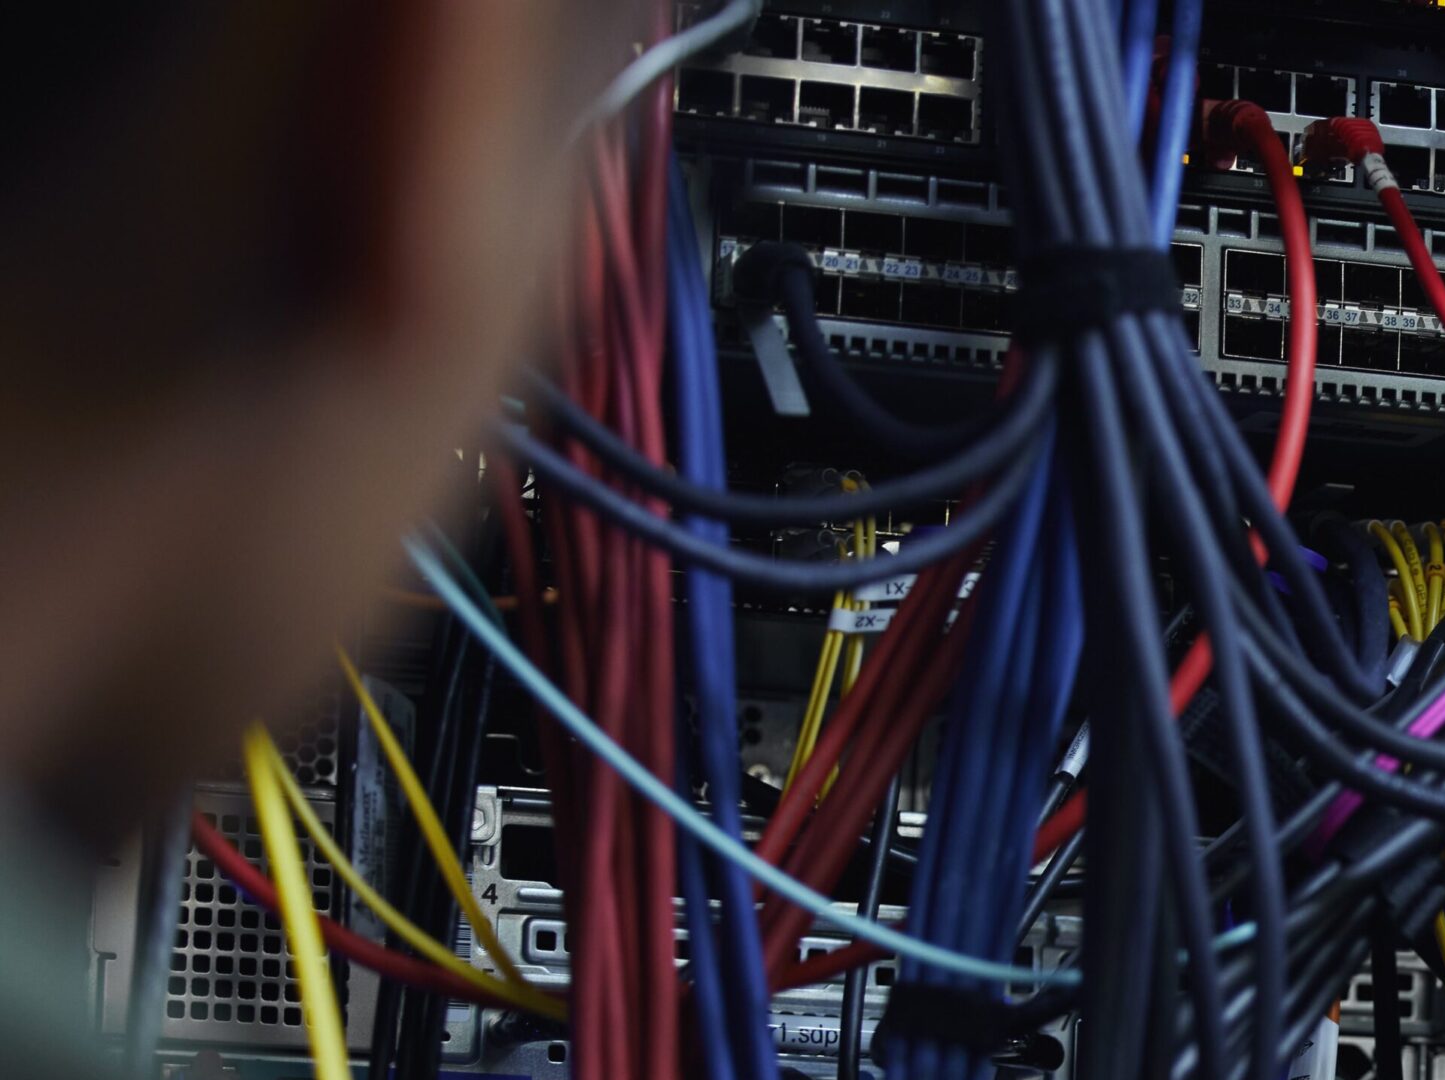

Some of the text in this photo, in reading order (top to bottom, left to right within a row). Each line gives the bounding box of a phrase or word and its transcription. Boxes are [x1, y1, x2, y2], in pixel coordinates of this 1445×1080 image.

[825, 254, 839, 269] 20
[846, 256, 859, 270] 21
[886, 261, 900, 275] 22
[905, 263, 920, 277] 23
[946, 268, 960, 280] 24
[965, 269, 979, 281] 25
[1184, 292, 1198, 303] 32
[1228, 299, 1242, 310] 33
[1268, 303, 1281, 314] 34
[1326, 310, 1339, 321] 36
[1344, 311, 1358, 322] 37
[1384, 315, 1397, 327] 38
[1402, 317, 1415, 328] 39
[481, 882, 499, 905] 4
